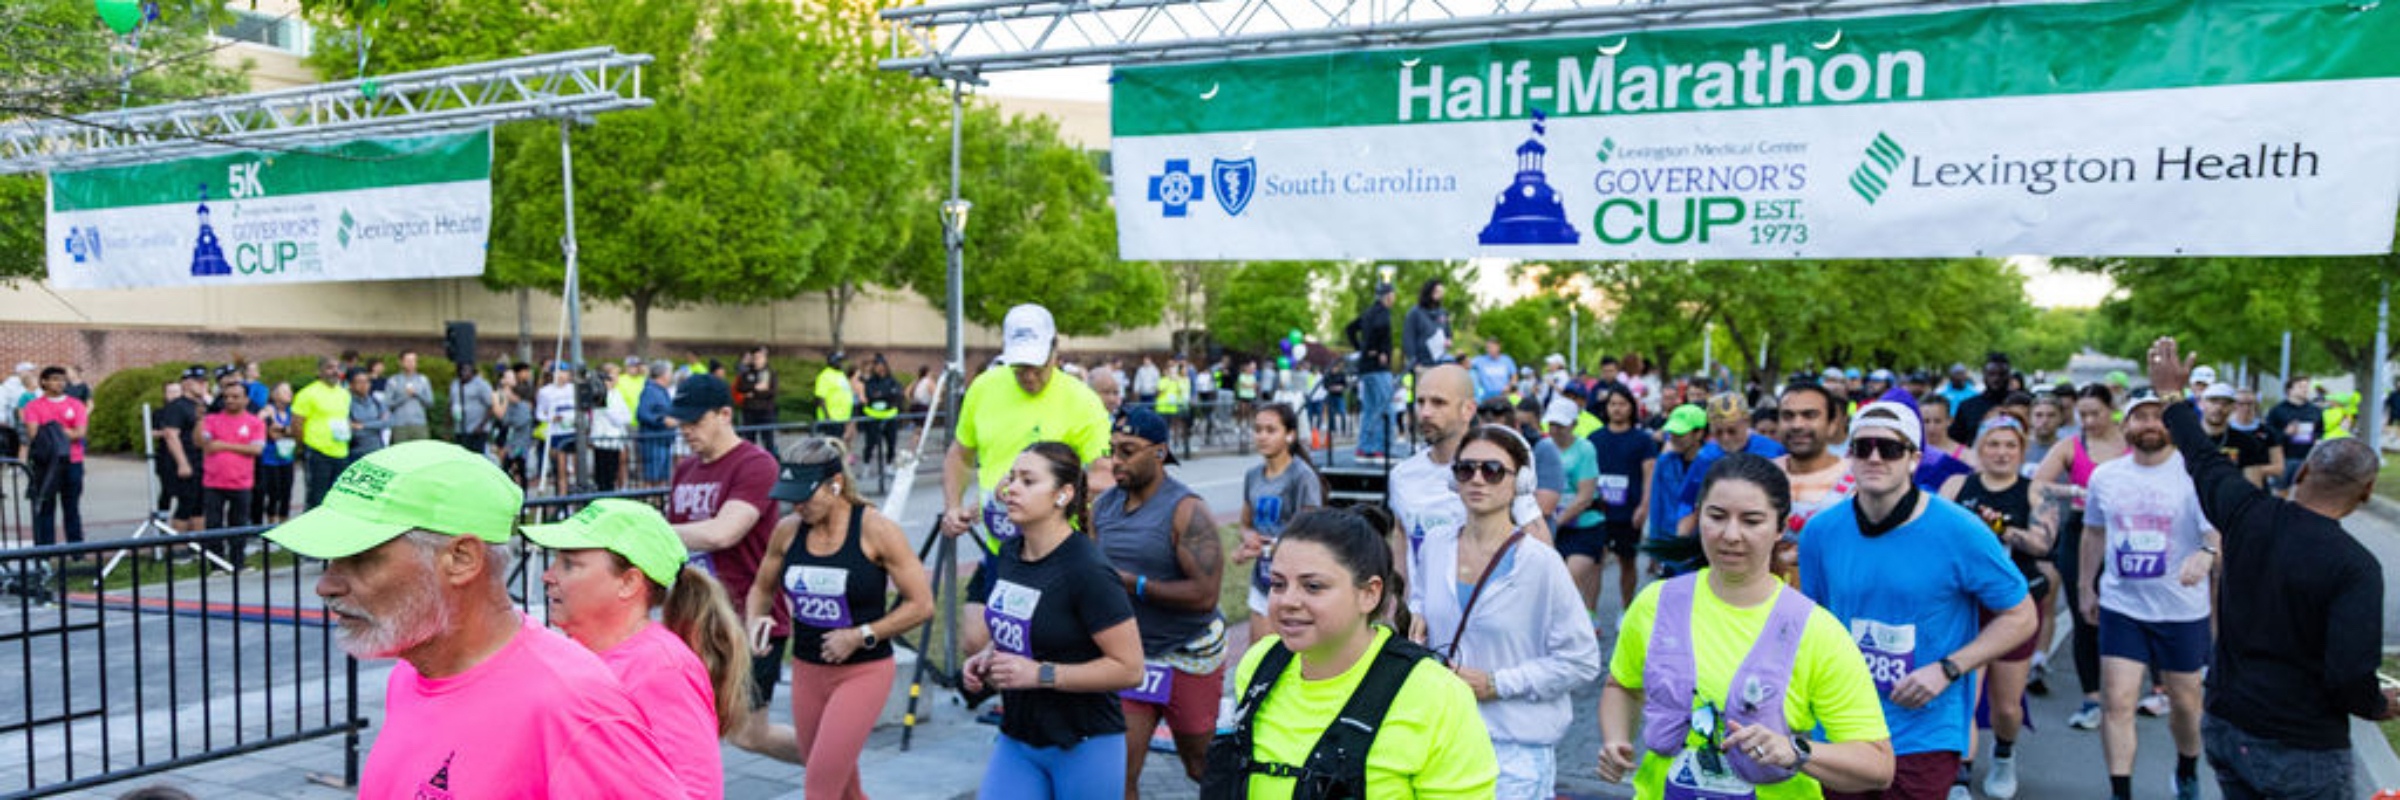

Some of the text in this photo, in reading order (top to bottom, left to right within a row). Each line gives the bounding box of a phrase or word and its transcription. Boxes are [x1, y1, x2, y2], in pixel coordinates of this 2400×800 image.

[1398, 44, 1926, 121] Half-Marathon
[1617, 140, 1808, 161] Lexington Medical Center
[229, 162, 264, 198] 5K
[1265, 167, 1457, 197] South Carolina
[1594, 163, 1807, 195] GOVERNOR'S
[1911, 142, 2320, 195] Lexington Health
[1593, 197, 1746, 245] CUP
[1754, 200, 1804, 220] EST.
[1751, 224, 1809, 245] 1973
[236, 240, 298, 274] CUP
[2121, 554, 2160, 574] 677
[797, 596, 841, 620] 229
[991, 617, 1024, 652] 228
